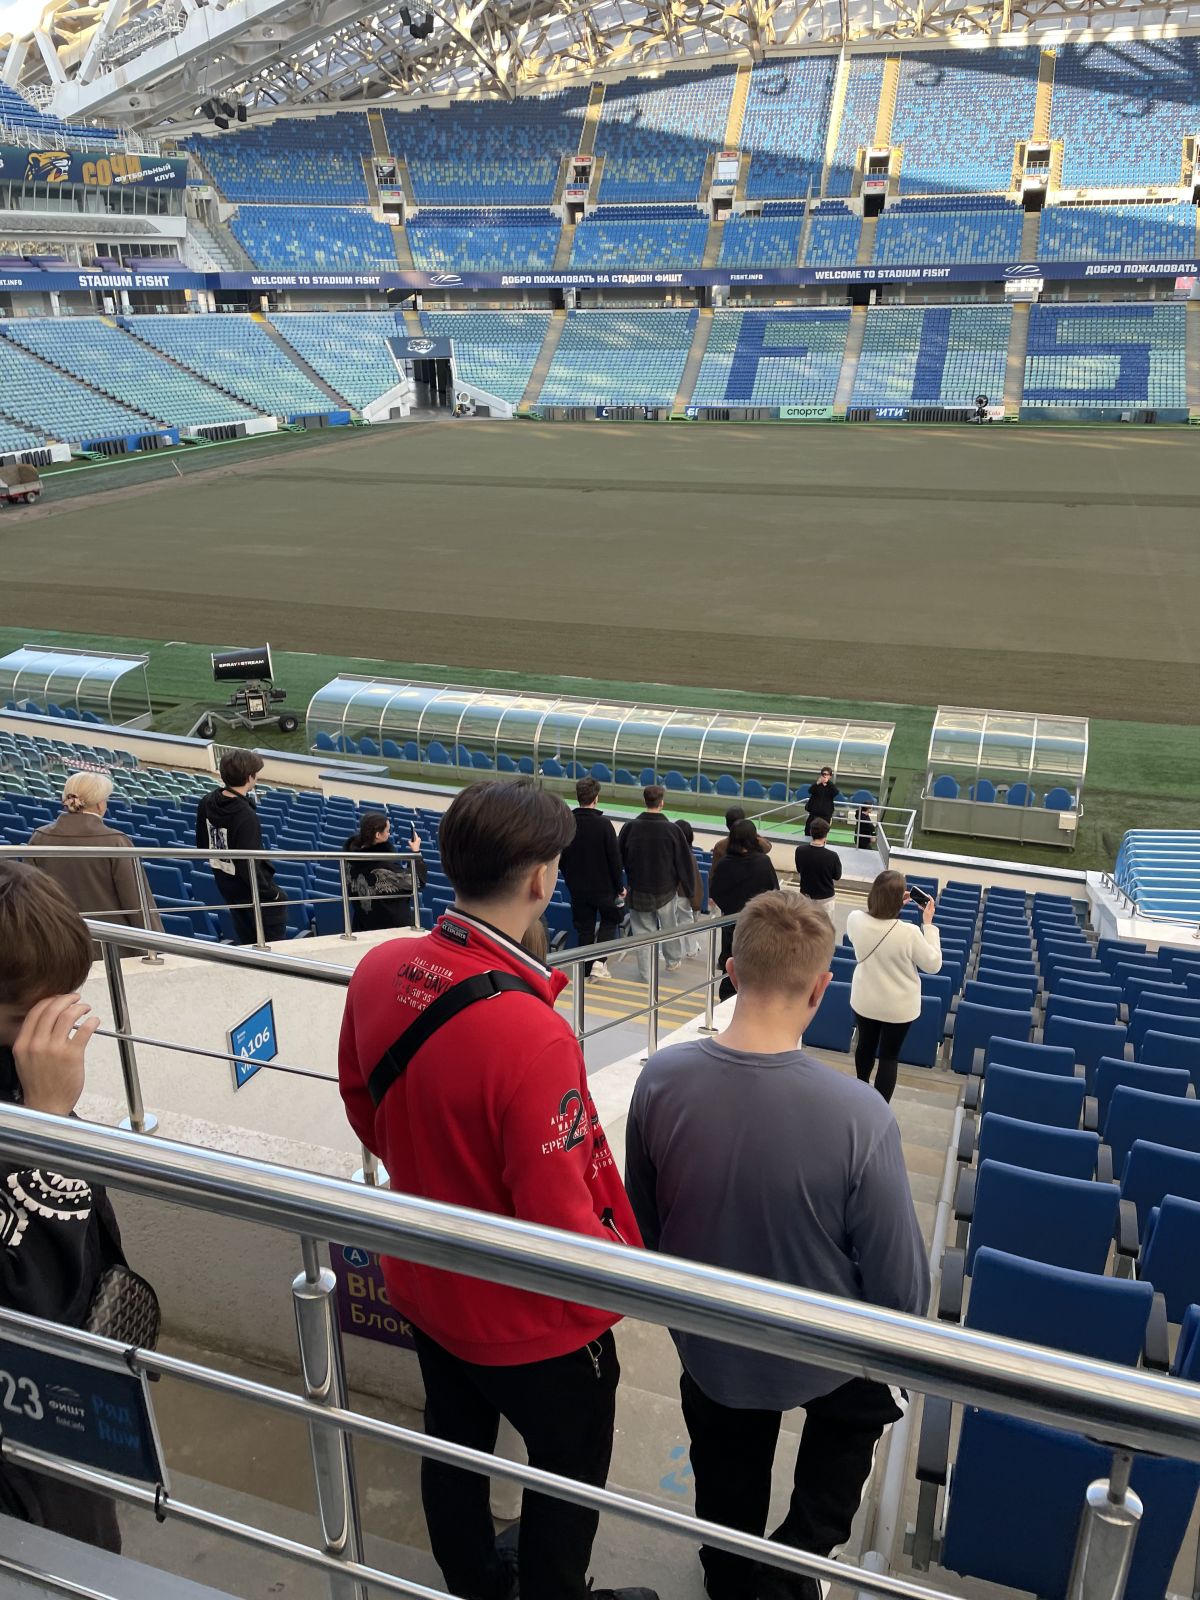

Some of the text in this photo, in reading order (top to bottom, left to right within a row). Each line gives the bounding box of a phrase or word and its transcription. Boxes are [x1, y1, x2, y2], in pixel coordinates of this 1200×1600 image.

[114, 163, 171, 183] ФУТБОЛЬНЫЙ
[154, 172, 176, 183] КЛУБ
[815, 269, 950, 280] WELCOME TO STADIUM FISHT
[1086, 264, 1198, 275] ДОБРО ПОЖАЛОВАТЬ
[79, 275, 170, 287] STADIUM FISHT
[251, 276, 381, 285] WELCOME TO STADIUM FISHT
[501, 273, 683, 285] ДОБРО ПОЖАЛОВАТЬ НА СТАДИОН ФИШТ
[240, 1026, 270, 1059] A106
[351, 1249, 362, 1262] A
[351, 1303, 413, 1337] Блок
